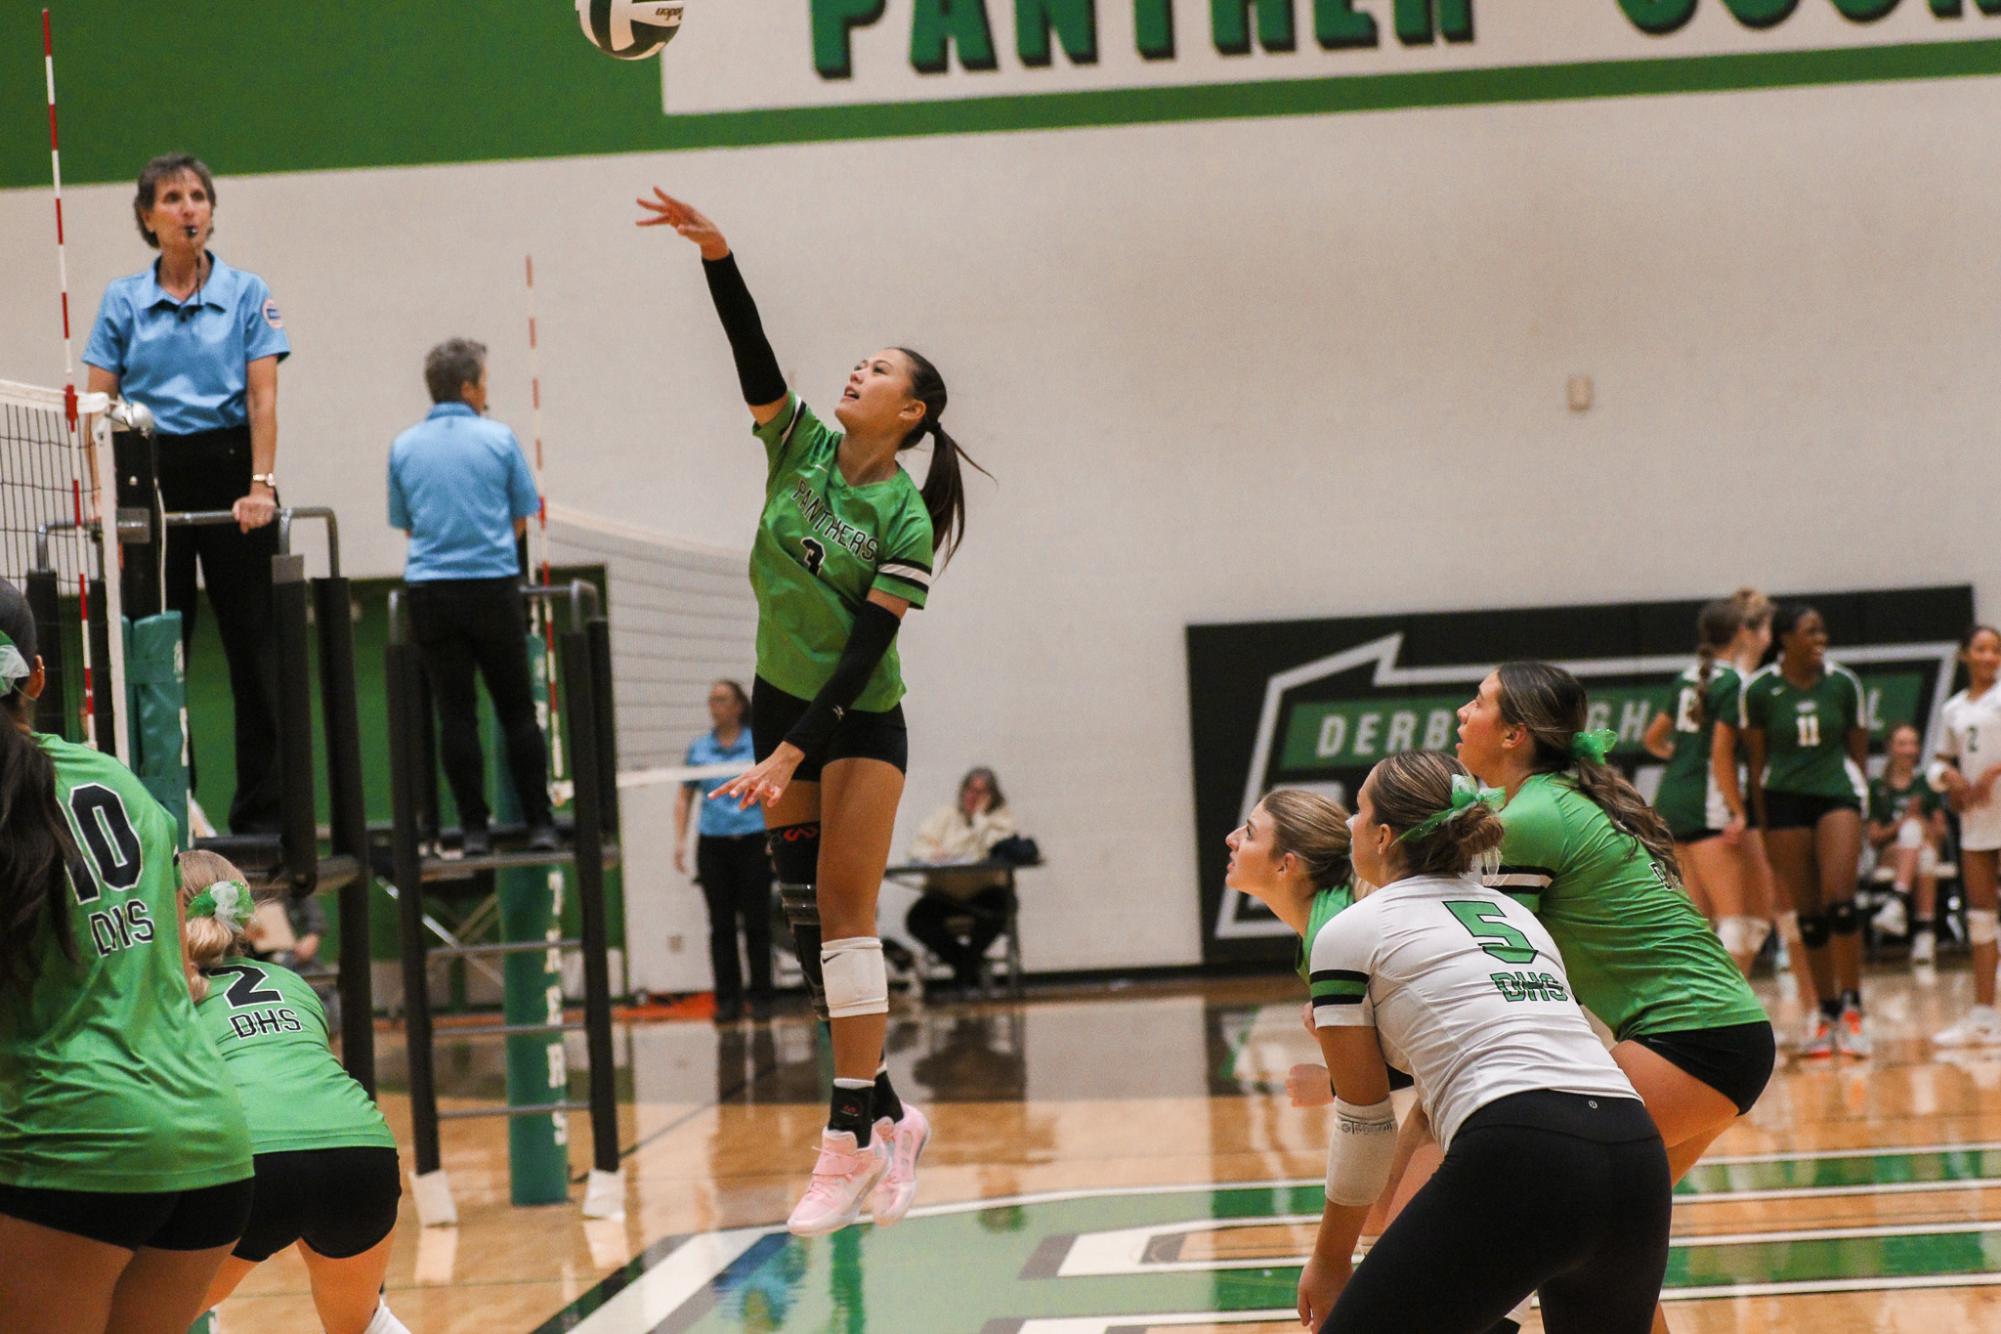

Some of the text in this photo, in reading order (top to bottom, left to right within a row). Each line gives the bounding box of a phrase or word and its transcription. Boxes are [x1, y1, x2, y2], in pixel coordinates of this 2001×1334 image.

[791, 479, 878, 562] PANTHERS
[1315, 701, 1650, 758] DERB GH
[1796, 715, 1821, 747] 11
[1441, 900, 1539, 964] 5
[207, 964, 284, 1009] 2
[1489, 971, 1569, 1003] DHS
[228, 1008, 303, 1040] DHS
